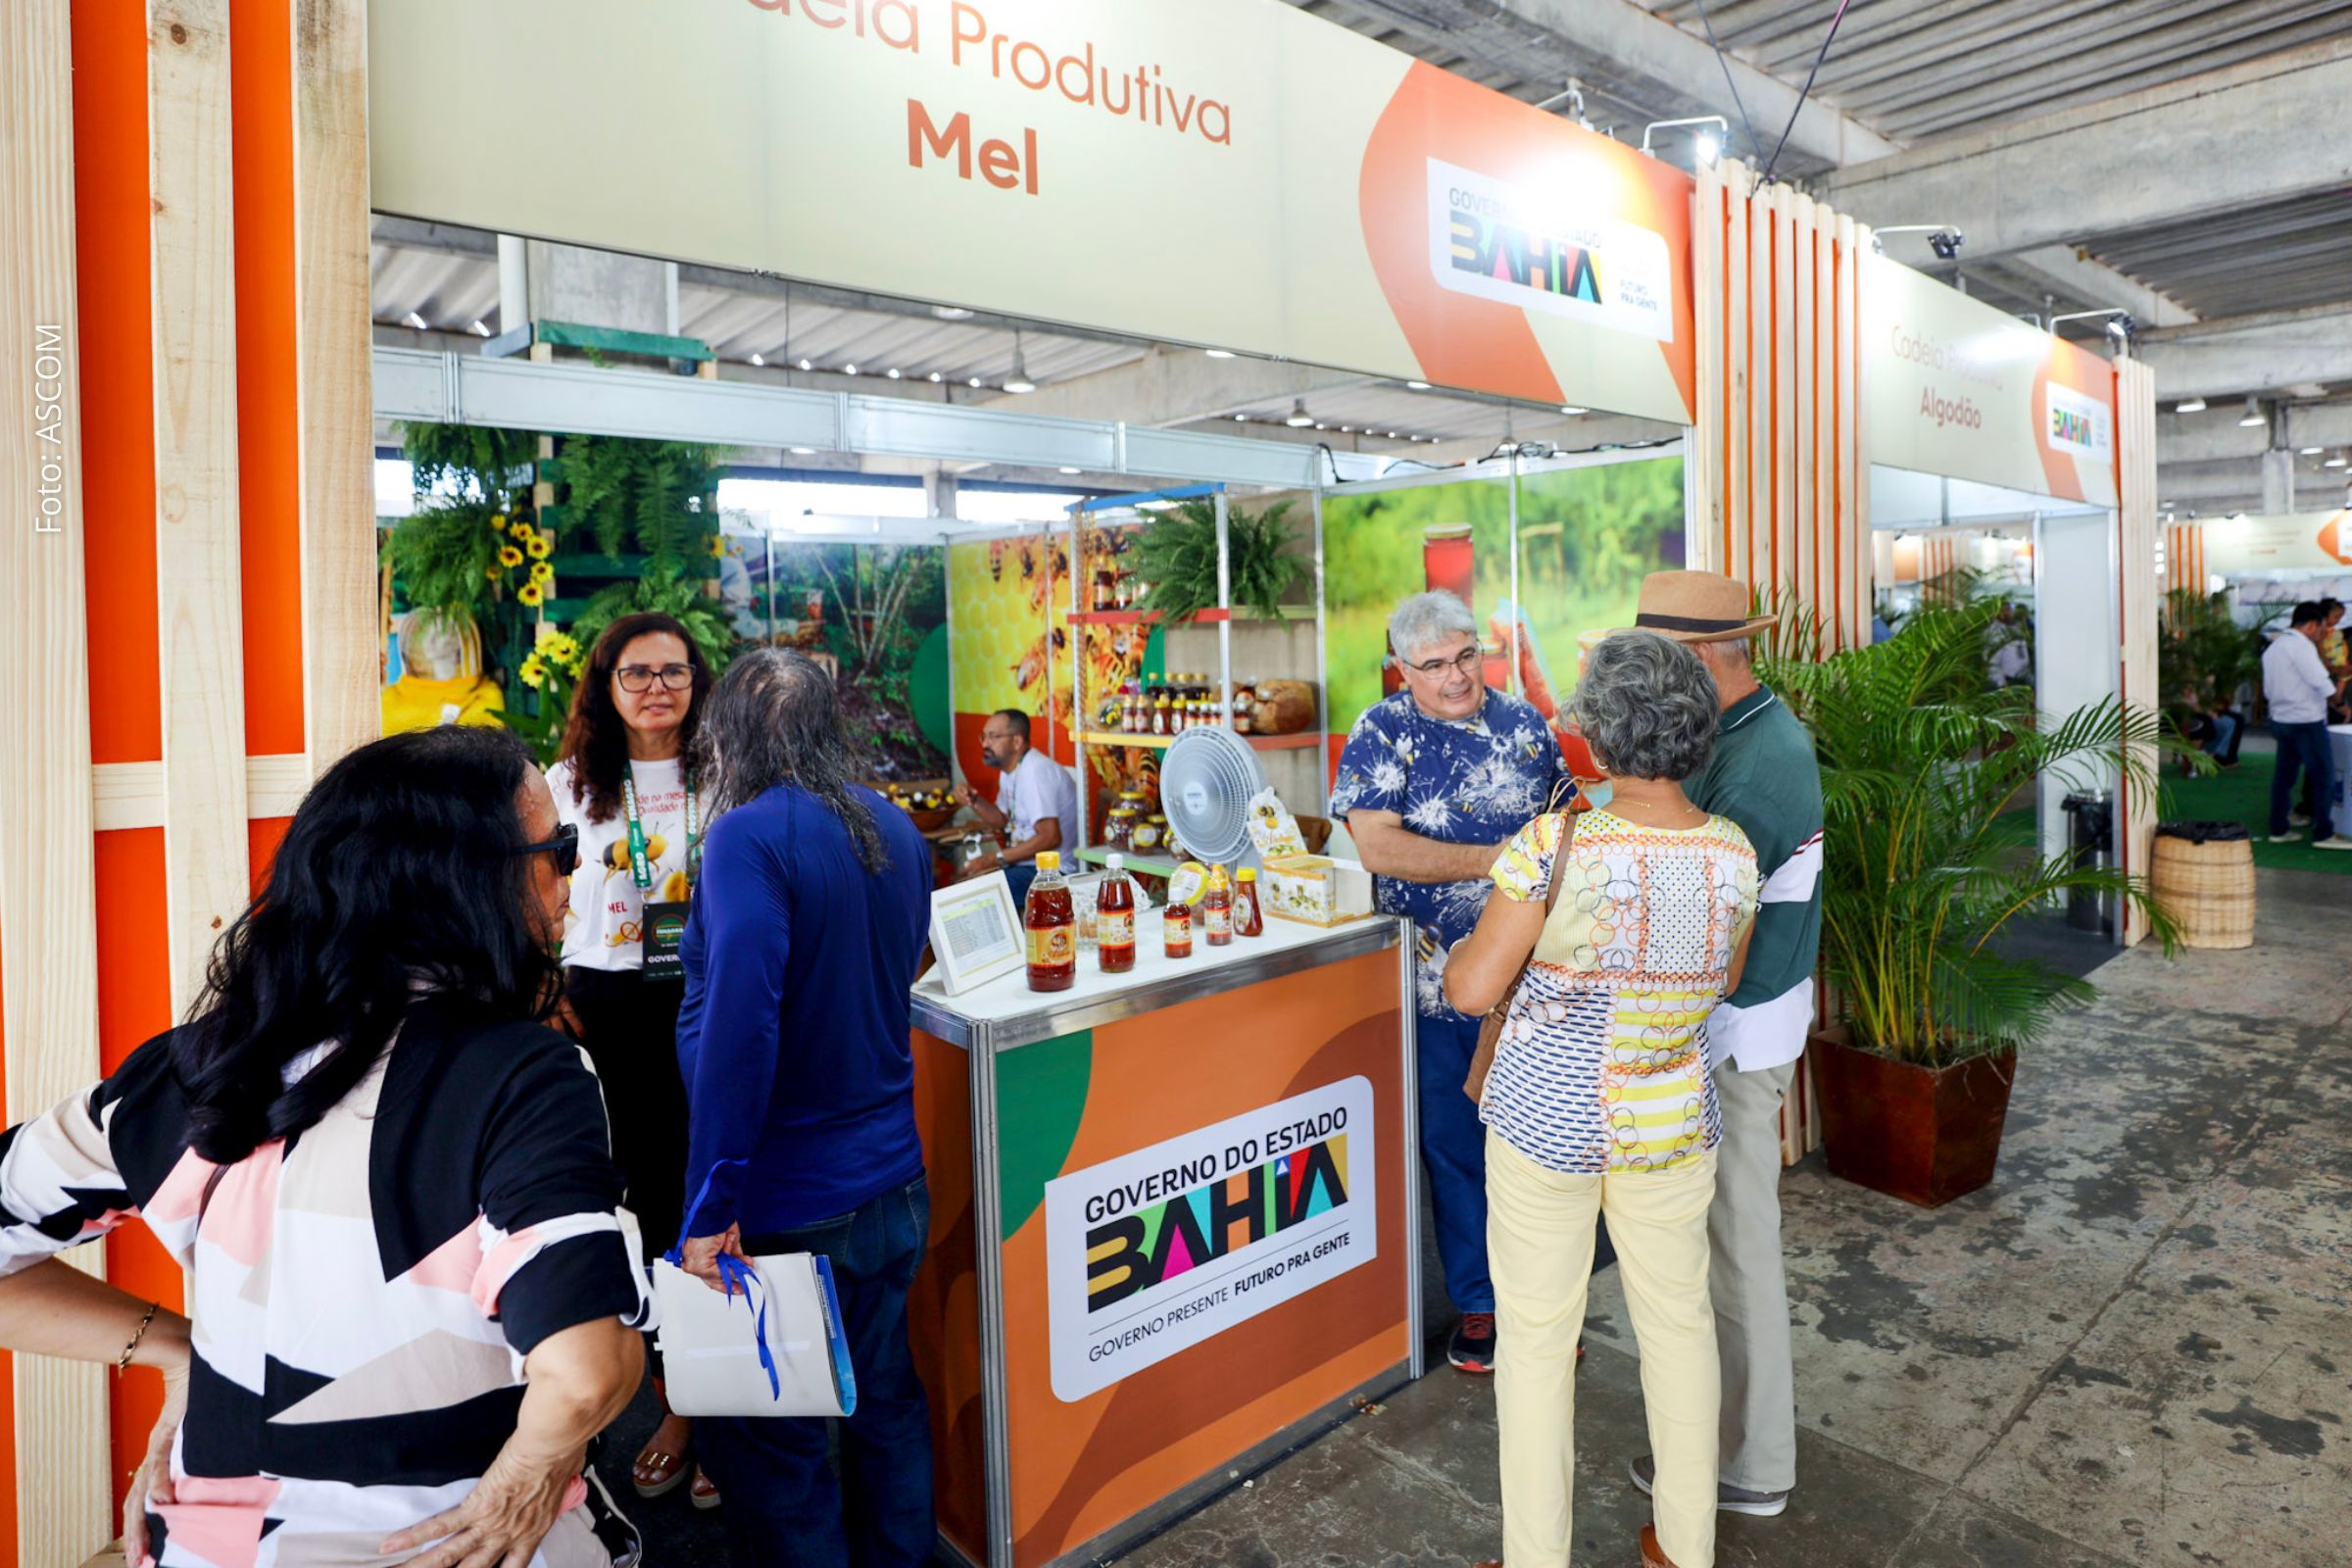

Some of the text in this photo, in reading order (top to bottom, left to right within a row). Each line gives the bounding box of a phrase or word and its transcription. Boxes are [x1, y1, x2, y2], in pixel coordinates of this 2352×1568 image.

[951, 0, 1231, 146] Produtiva
[906, 98, 1039, 196] Mel
[1449, 209, 1602, 305] BAHIA
[1920, 386, 1982, 429] Algodão
[2053, 408, 2092, 448] BAHIA
[1085, 1106, 1348, 1223] GOVERNO DO ESTADO
[1086, 1132, 1348, 1313] BAHIA
[1088, 1231, 1350, 1362] GOVERNO PRESENTE FUTURO PRA GENTE
